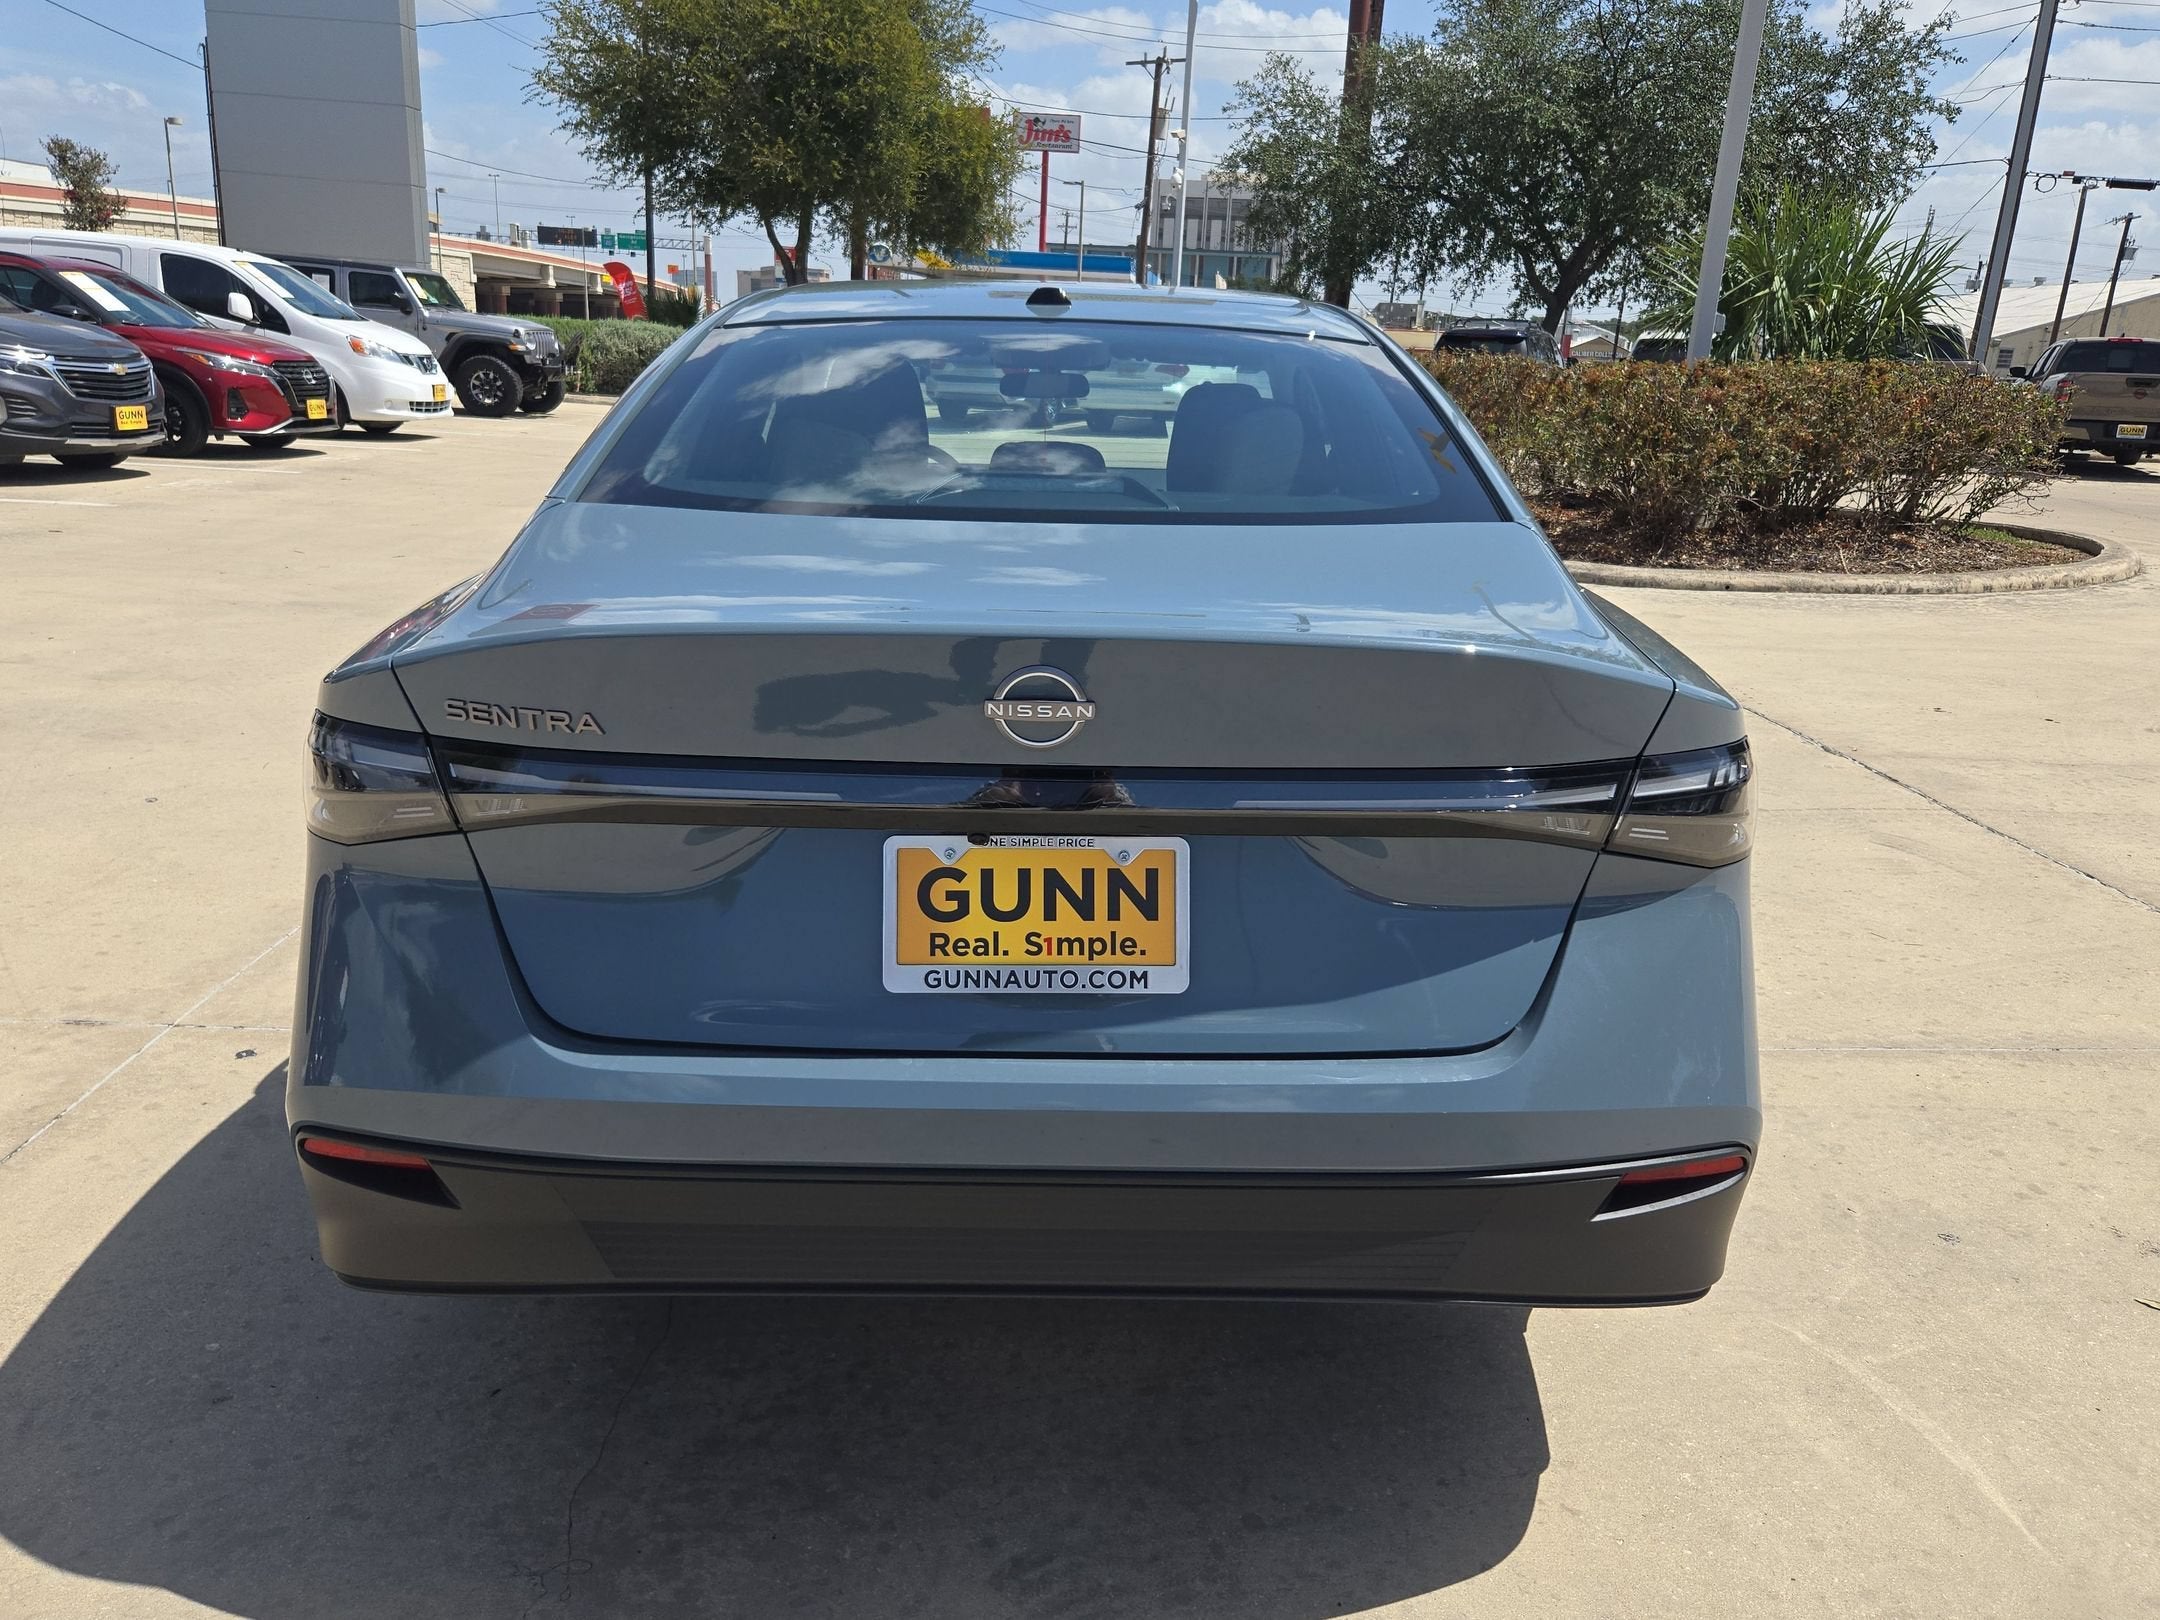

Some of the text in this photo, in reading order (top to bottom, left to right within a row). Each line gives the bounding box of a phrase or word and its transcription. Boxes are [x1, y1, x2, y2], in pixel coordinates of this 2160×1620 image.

[1018, 119, 1072, 145] Jim's
[118, 410, 144, 420] GUNN
[2119, 426, 2145, 434] GUNN
[443, 698, 607, 736] SENTRA
[986, 703, 1094, 718] NISSAN
[1010, 837, 1054, 848] SIMPLE
[1058, 838, 1095, 848] PRICE
[917, 866, 1160, 923] GUNN
[929, 931, 1010, 957] Real.
[923, 968, 1150, 990] GUNNAUTO.COM
